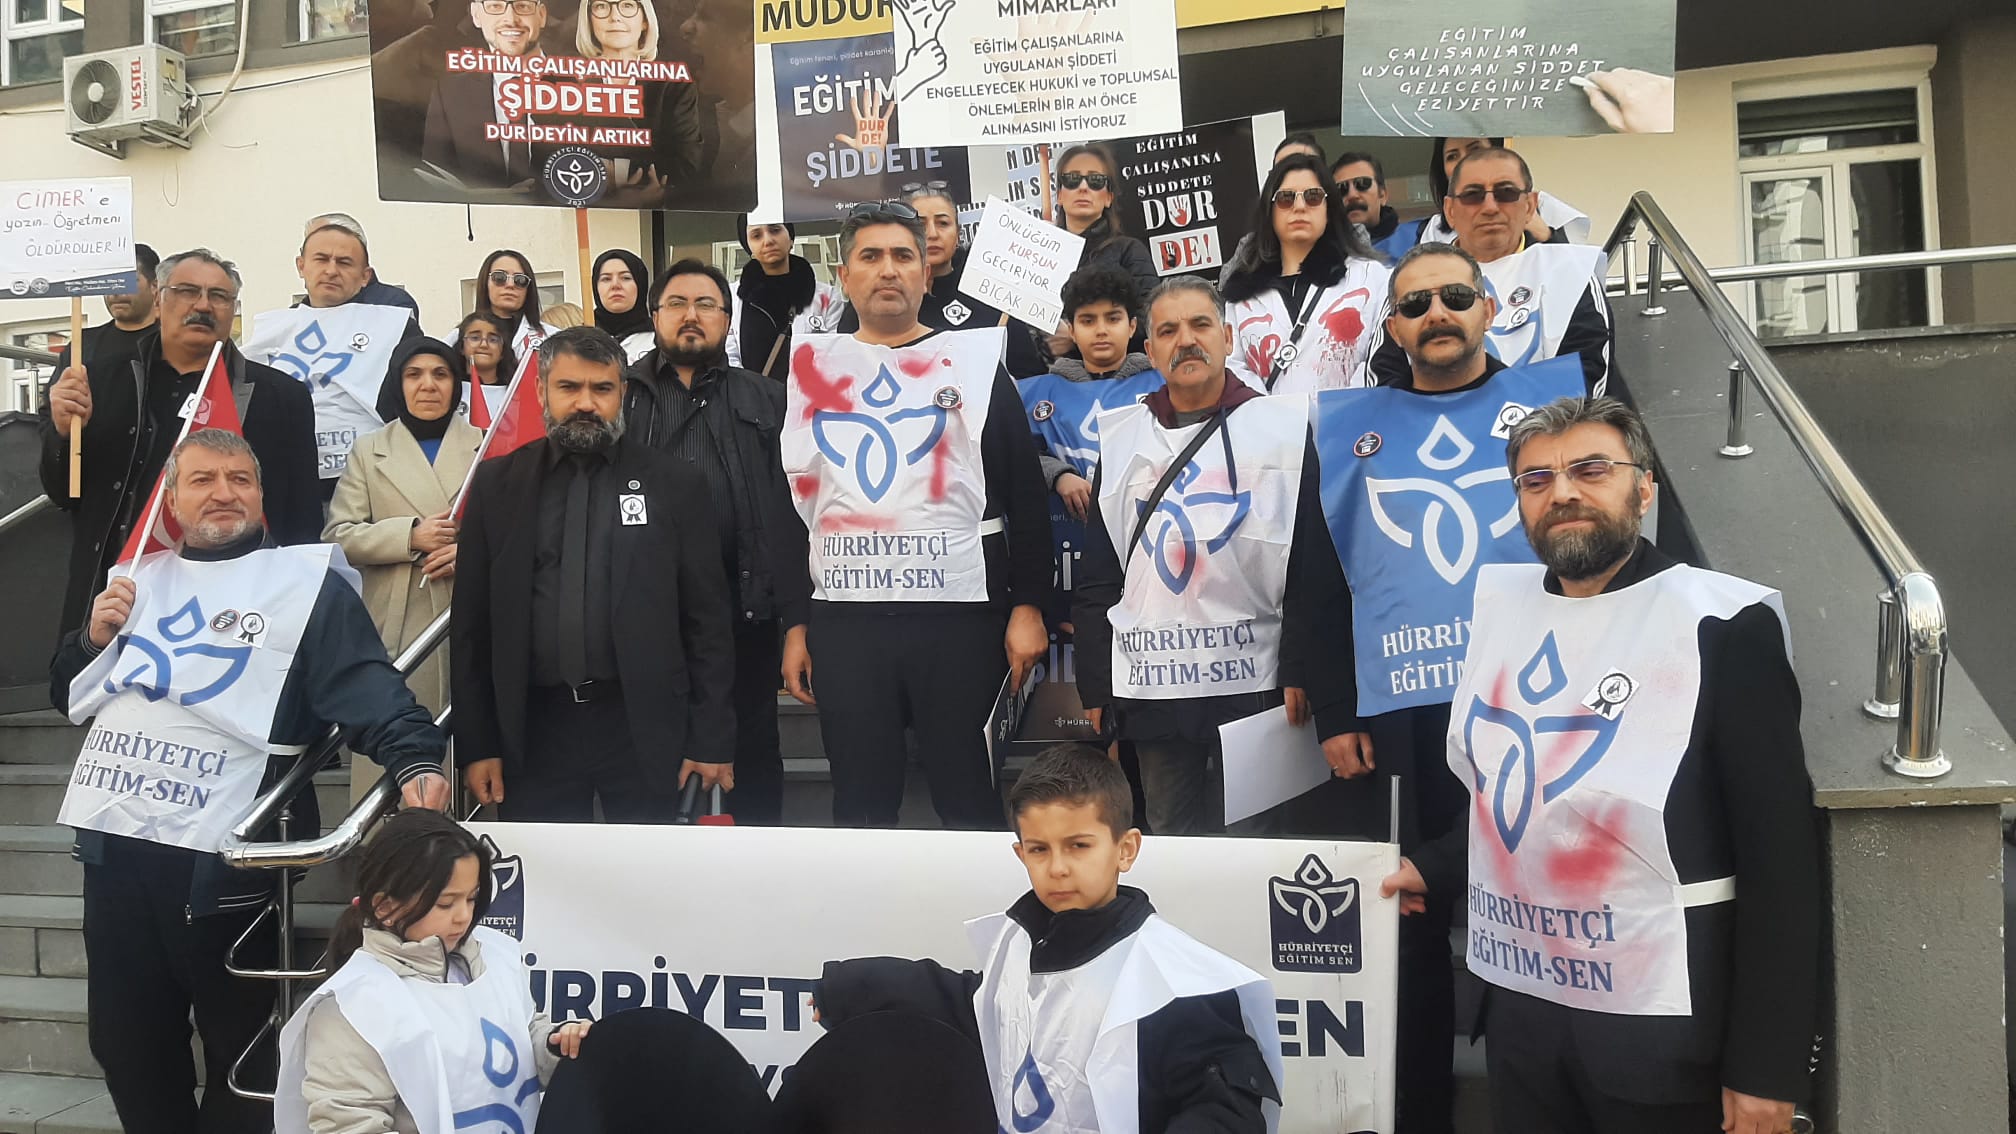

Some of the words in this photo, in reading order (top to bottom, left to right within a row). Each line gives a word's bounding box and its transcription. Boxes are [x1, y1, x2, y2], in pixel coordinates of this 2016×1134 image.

[974, 37, 1017, 54] EĞİTİM
[1021, 31, 1124, 53] ÇALIŞANLARINA
[448, 49, 521, 73] EĞİTİM
[528, 57, 690, 81] ÇALIŞANLARINA
[984, 56, 1064, 74] UYGULANAN
[1068, 49, 1117, 70] ŞİDDETİ
[1362, 63, 1499, 78] UYGULANAN
[131, 56, 141, 111] VESTEL
[503, 77, 641, 117] ŞİDDETE
[793, 71, 897, 116] EĞİTİM
[926, 81, 1026, 99] ENGELLEYECEK
[1030, 73, 1078, 91] HUKUKİ
[1082, 77, 1096, 87] ve
[1100, 67, 1178, 86] TOPLUMSAL
[968, 96, 1051, 117] ÖNLEMLERİN
[1054, 96, 1074, 110] BİR
[1079, 96, 1096, 109] AN
[1101, 92, 1137, 107] ÖNCE
[486, 124, 527, 140] DUR
[532, 124, 587, 143] DEYİN
[593, 128, 650, 145] ARTIK!
[859, 119, 885, 131] DUR
[861, 133, 882, 145] DE!
[982, 120, 1056, 136] ALINMASINI
[1060, 114, 1126, 131] İSTİYORUZ
[1136, 133, 1198, 154] EĞİTİM
[1122, 151, 1222, 180] ÇALIŞANINA
[1137, 174, 1213, 198] ŞİDDETE
[1142, 190, 1218, 230] DUR
[1008, 241, 1058, 271] KURŞUN
[1158, 233, 1212, 272] DE!
[978, 279, 1022, 309] BIÇAK
[1028, 302, 1045, 321] DA
[823, 531, 949, 561] HÜRRİYETÇİ
[824, 564, 945, 588] EĞİTİM-SEN
[1121, 619, 1256, 652] HÜRRİYETÇİ
[1128, 657, 1256, 686] EĞİTİM-SEN
[1469, 882, 1616, 949] HÜRRİYETÇİ
[1278, 941, 1353, 955] HÜRRİYETÇİ
[1279, 954, 1324, 965] EĞİTİM
[1329, 956, 1353, 966] SEN
[1472, 926, 1613, 993] EĞİTİM-SEN
